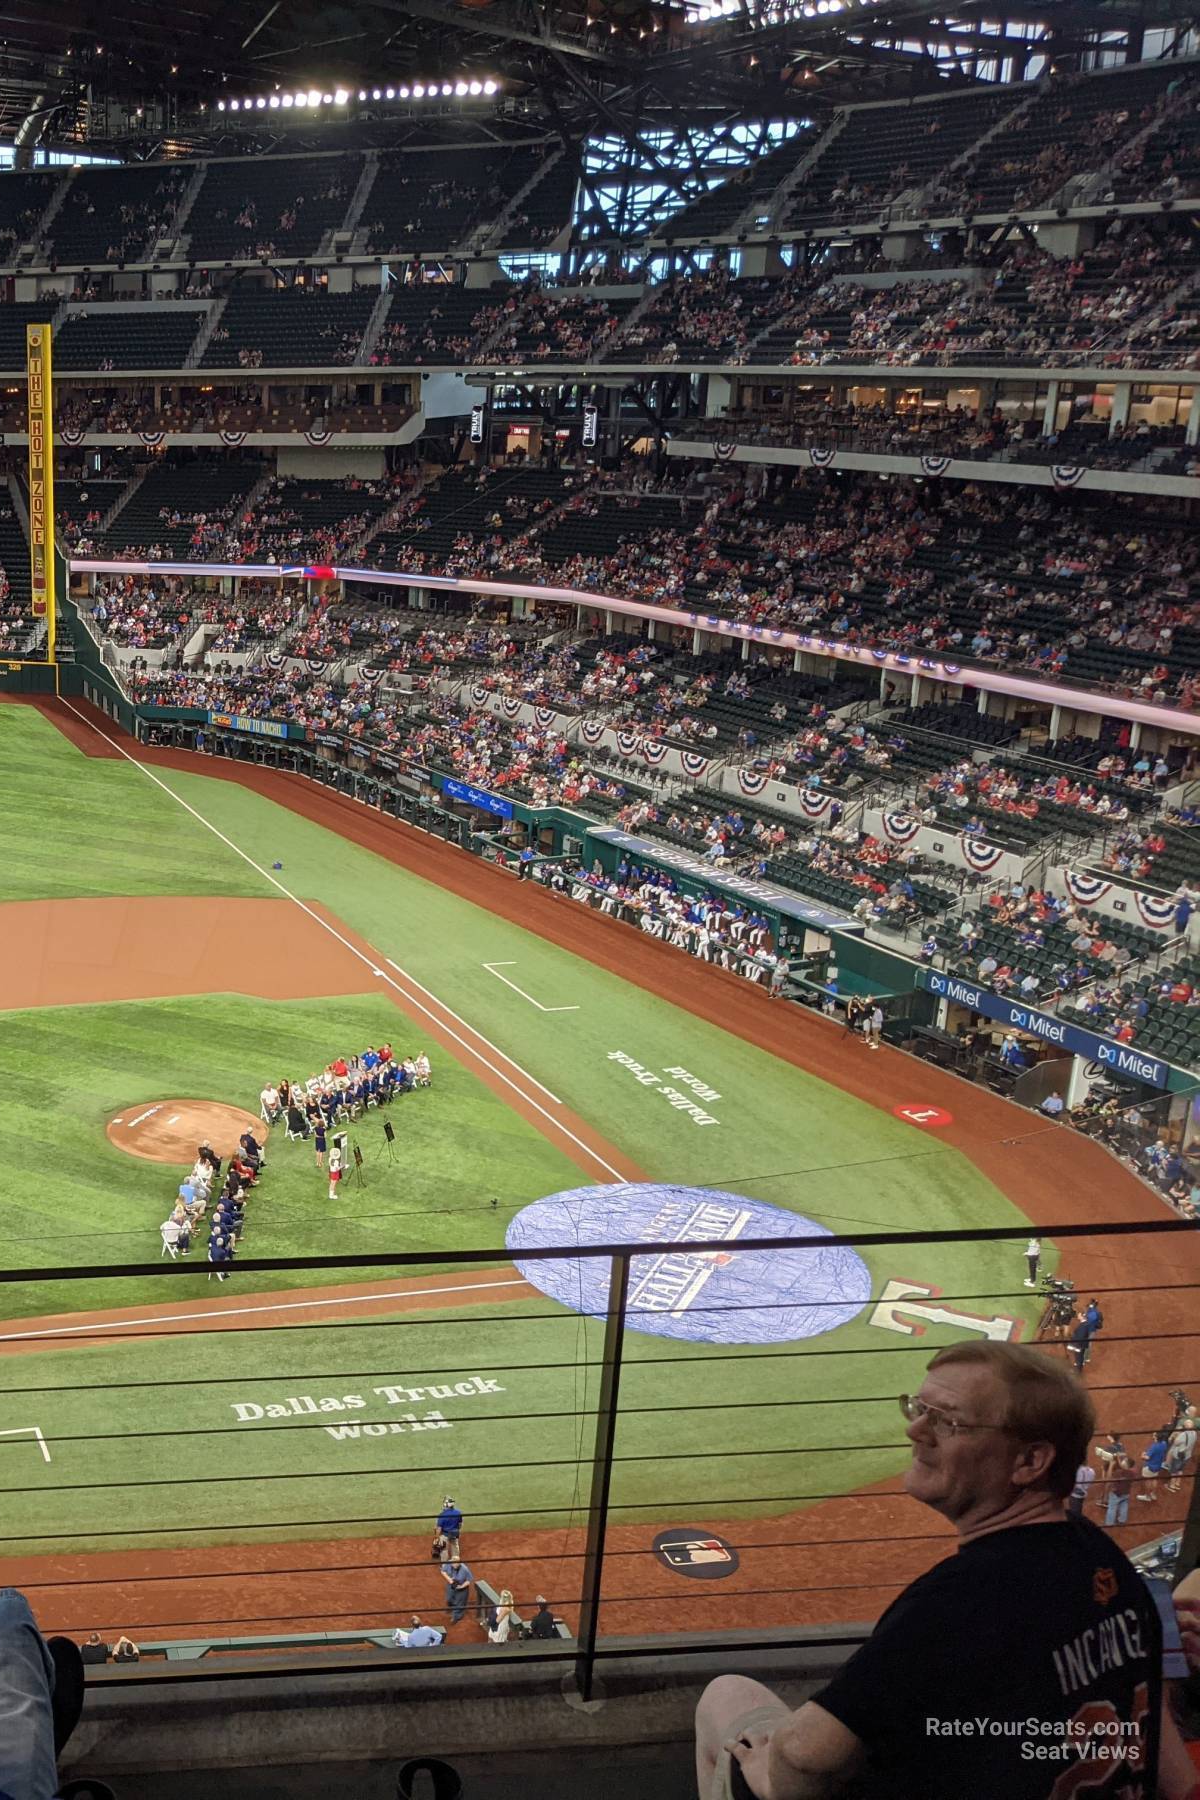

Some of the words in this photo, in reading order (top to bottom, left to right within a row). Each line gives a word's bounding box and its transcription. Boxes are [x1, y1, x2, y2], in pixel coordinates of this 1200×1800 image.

[31, 359, 41, 407] THE
[32, 421, 42, 467] HOT
[33, 482, 43, 544] ZONE
[236, 717, 251, 731] HOW
[252, 719, 260, 732] TO
[641, 847, 725, 877] RANGERS
[717, 877, 784, 901] TEXAS
[947, 981, 982, 1008] Mitel
[1028, 1014, 1065, 1043] Mitel
[606, 1050, 662, 1086] Truck
[662, 1066, 722, 1102] World
[1118, 1050, 1160, 1082] Mitel
[656, 1087, 720, 1126] Dallas
[631, 1262, 698, 1312] HALL
[869, 1278, 1018, 1342] T
[230, 1392, 367, 1422] Dallas
[373, 1376, 506, 1405] Truck
[323, 1411, 453, 1441] World
